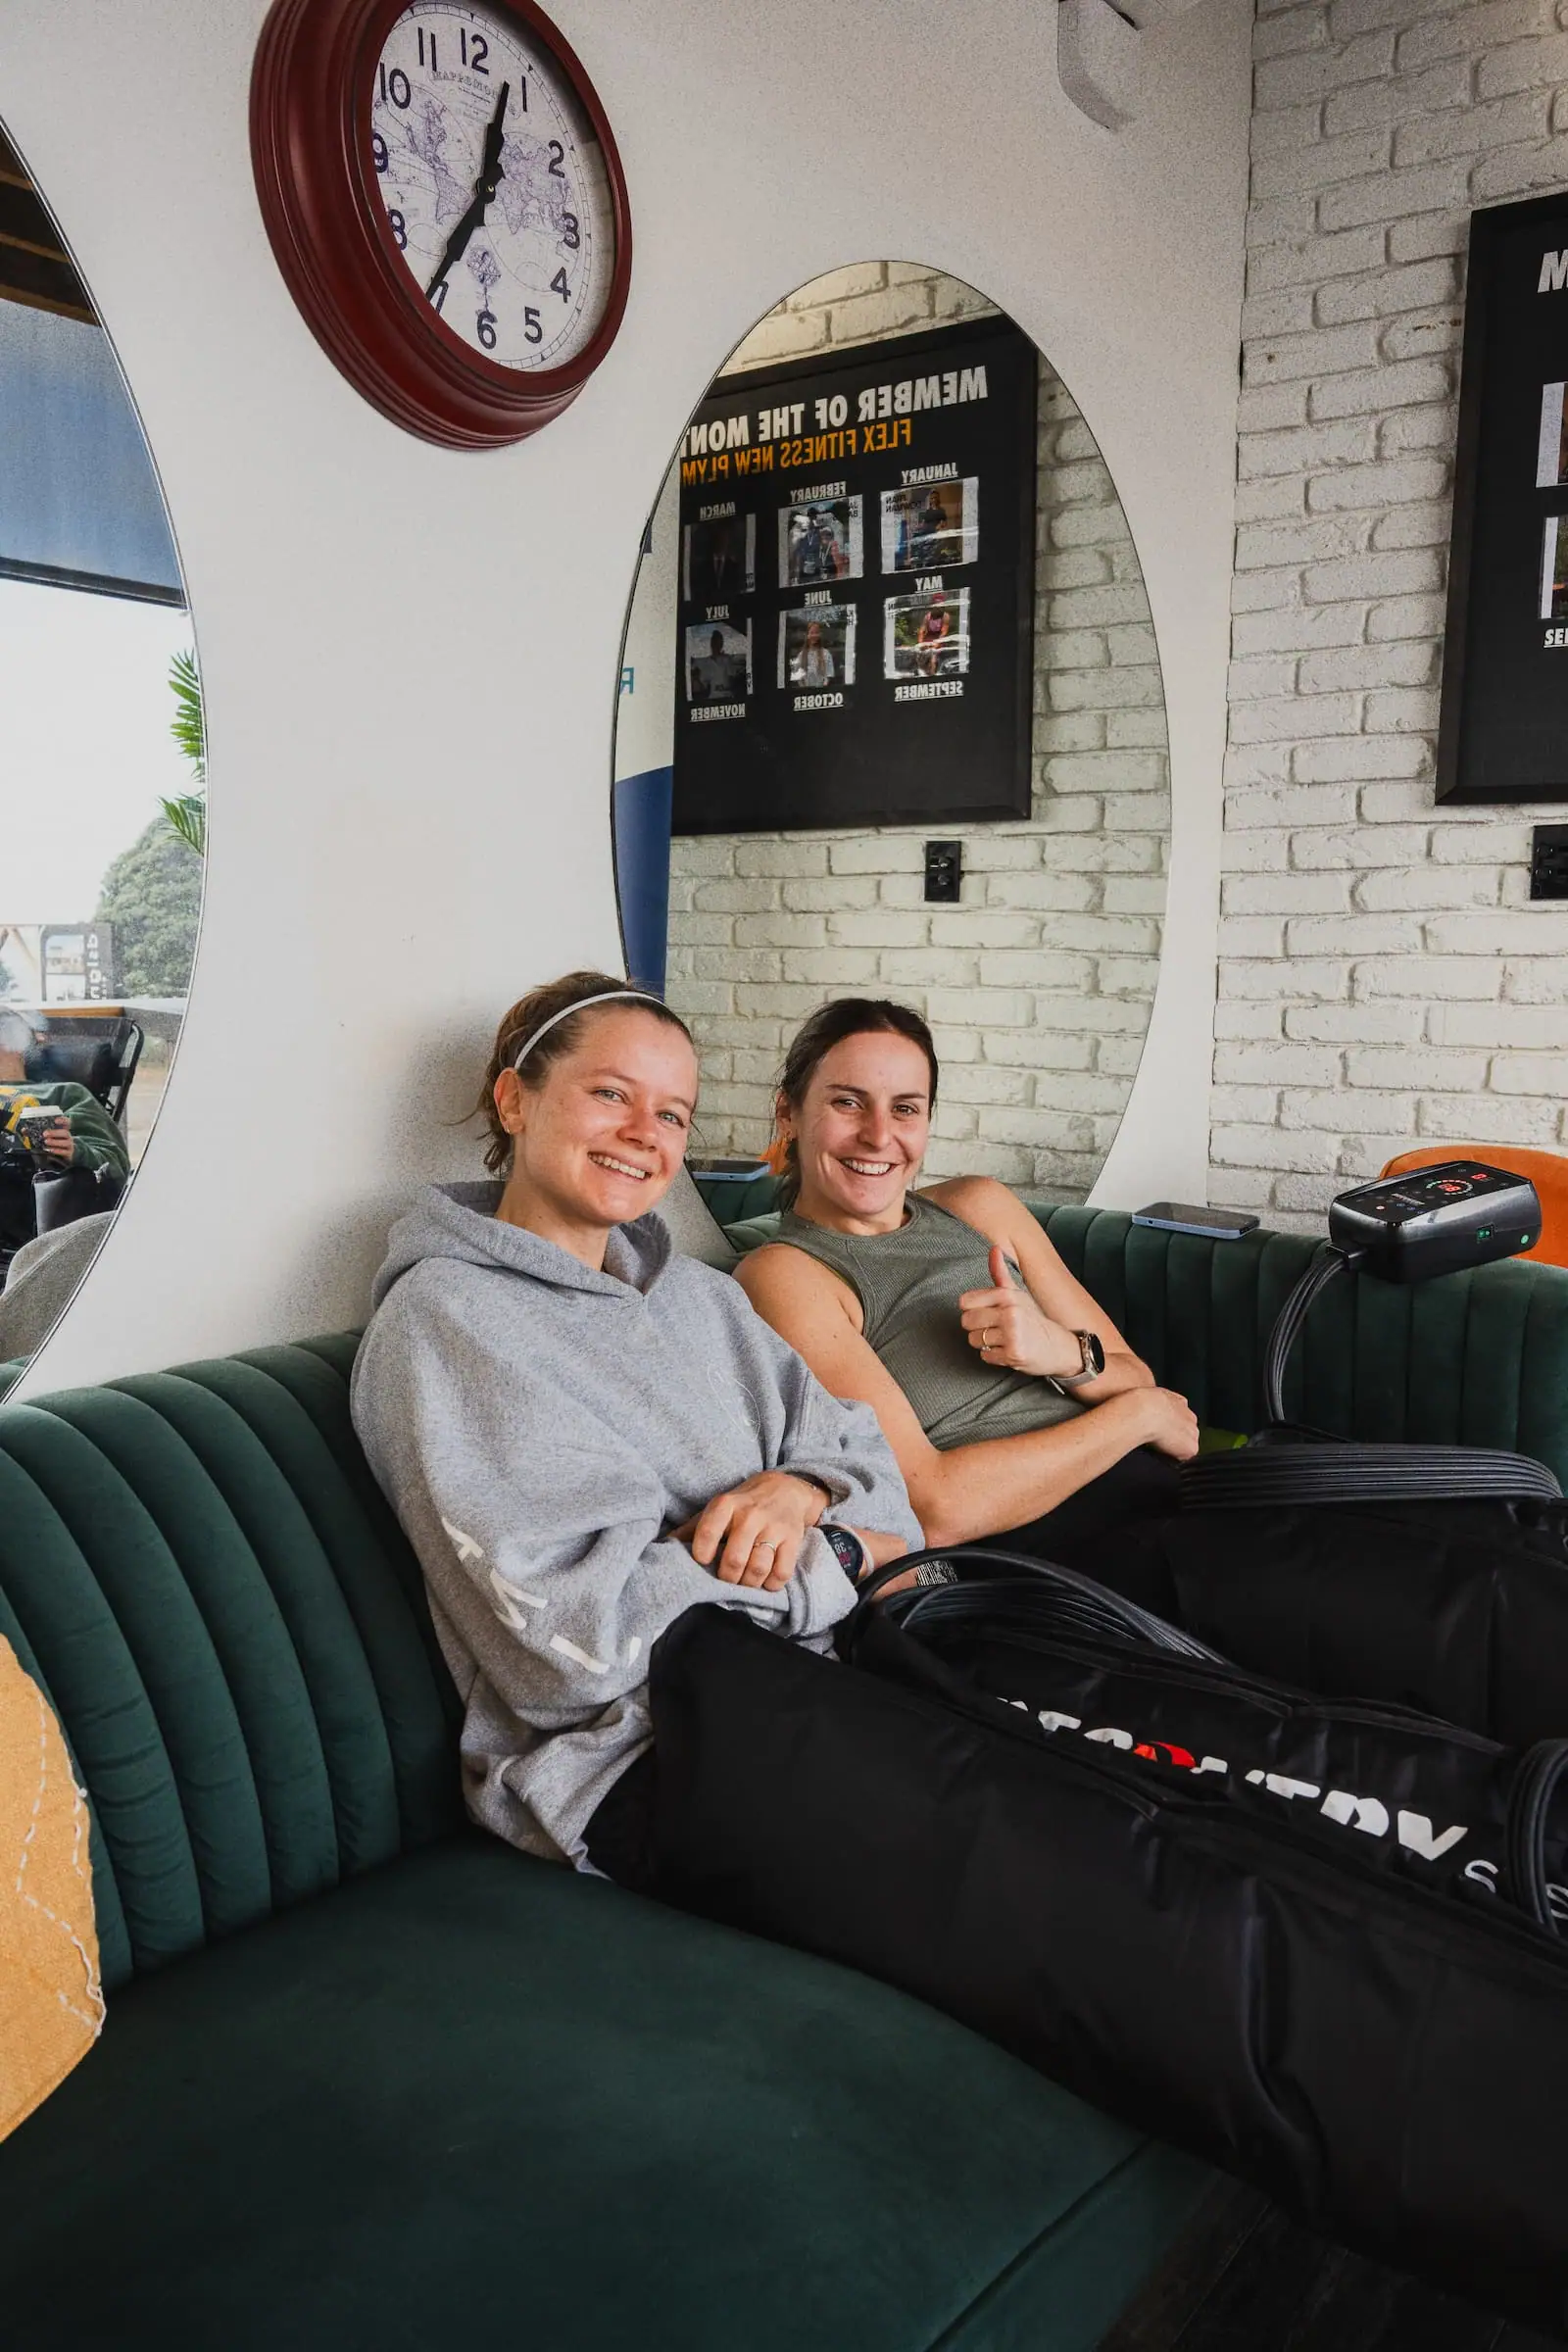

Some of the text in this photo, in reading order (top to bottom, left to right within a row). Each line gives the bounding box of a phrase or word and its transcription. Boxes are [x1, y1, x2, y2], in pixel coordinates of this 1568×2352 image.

[417, 26, 437, 73] 11
[461, 27, 489, 75] 12
[379, 62, 411, 110] 10
[521, 75, 527, 113] 1
[372, 132, 389, 173] 9
[548, 140, 564, 178] 2
[389, 209, 408, 251] 8
[562, 213, 580, 248] 3
[550, 267, 571, 304] 4
[476, 311, 498, 350] 6
[524, 307, 543, 344] 5
[1544, 627, 1568, 647] SE
